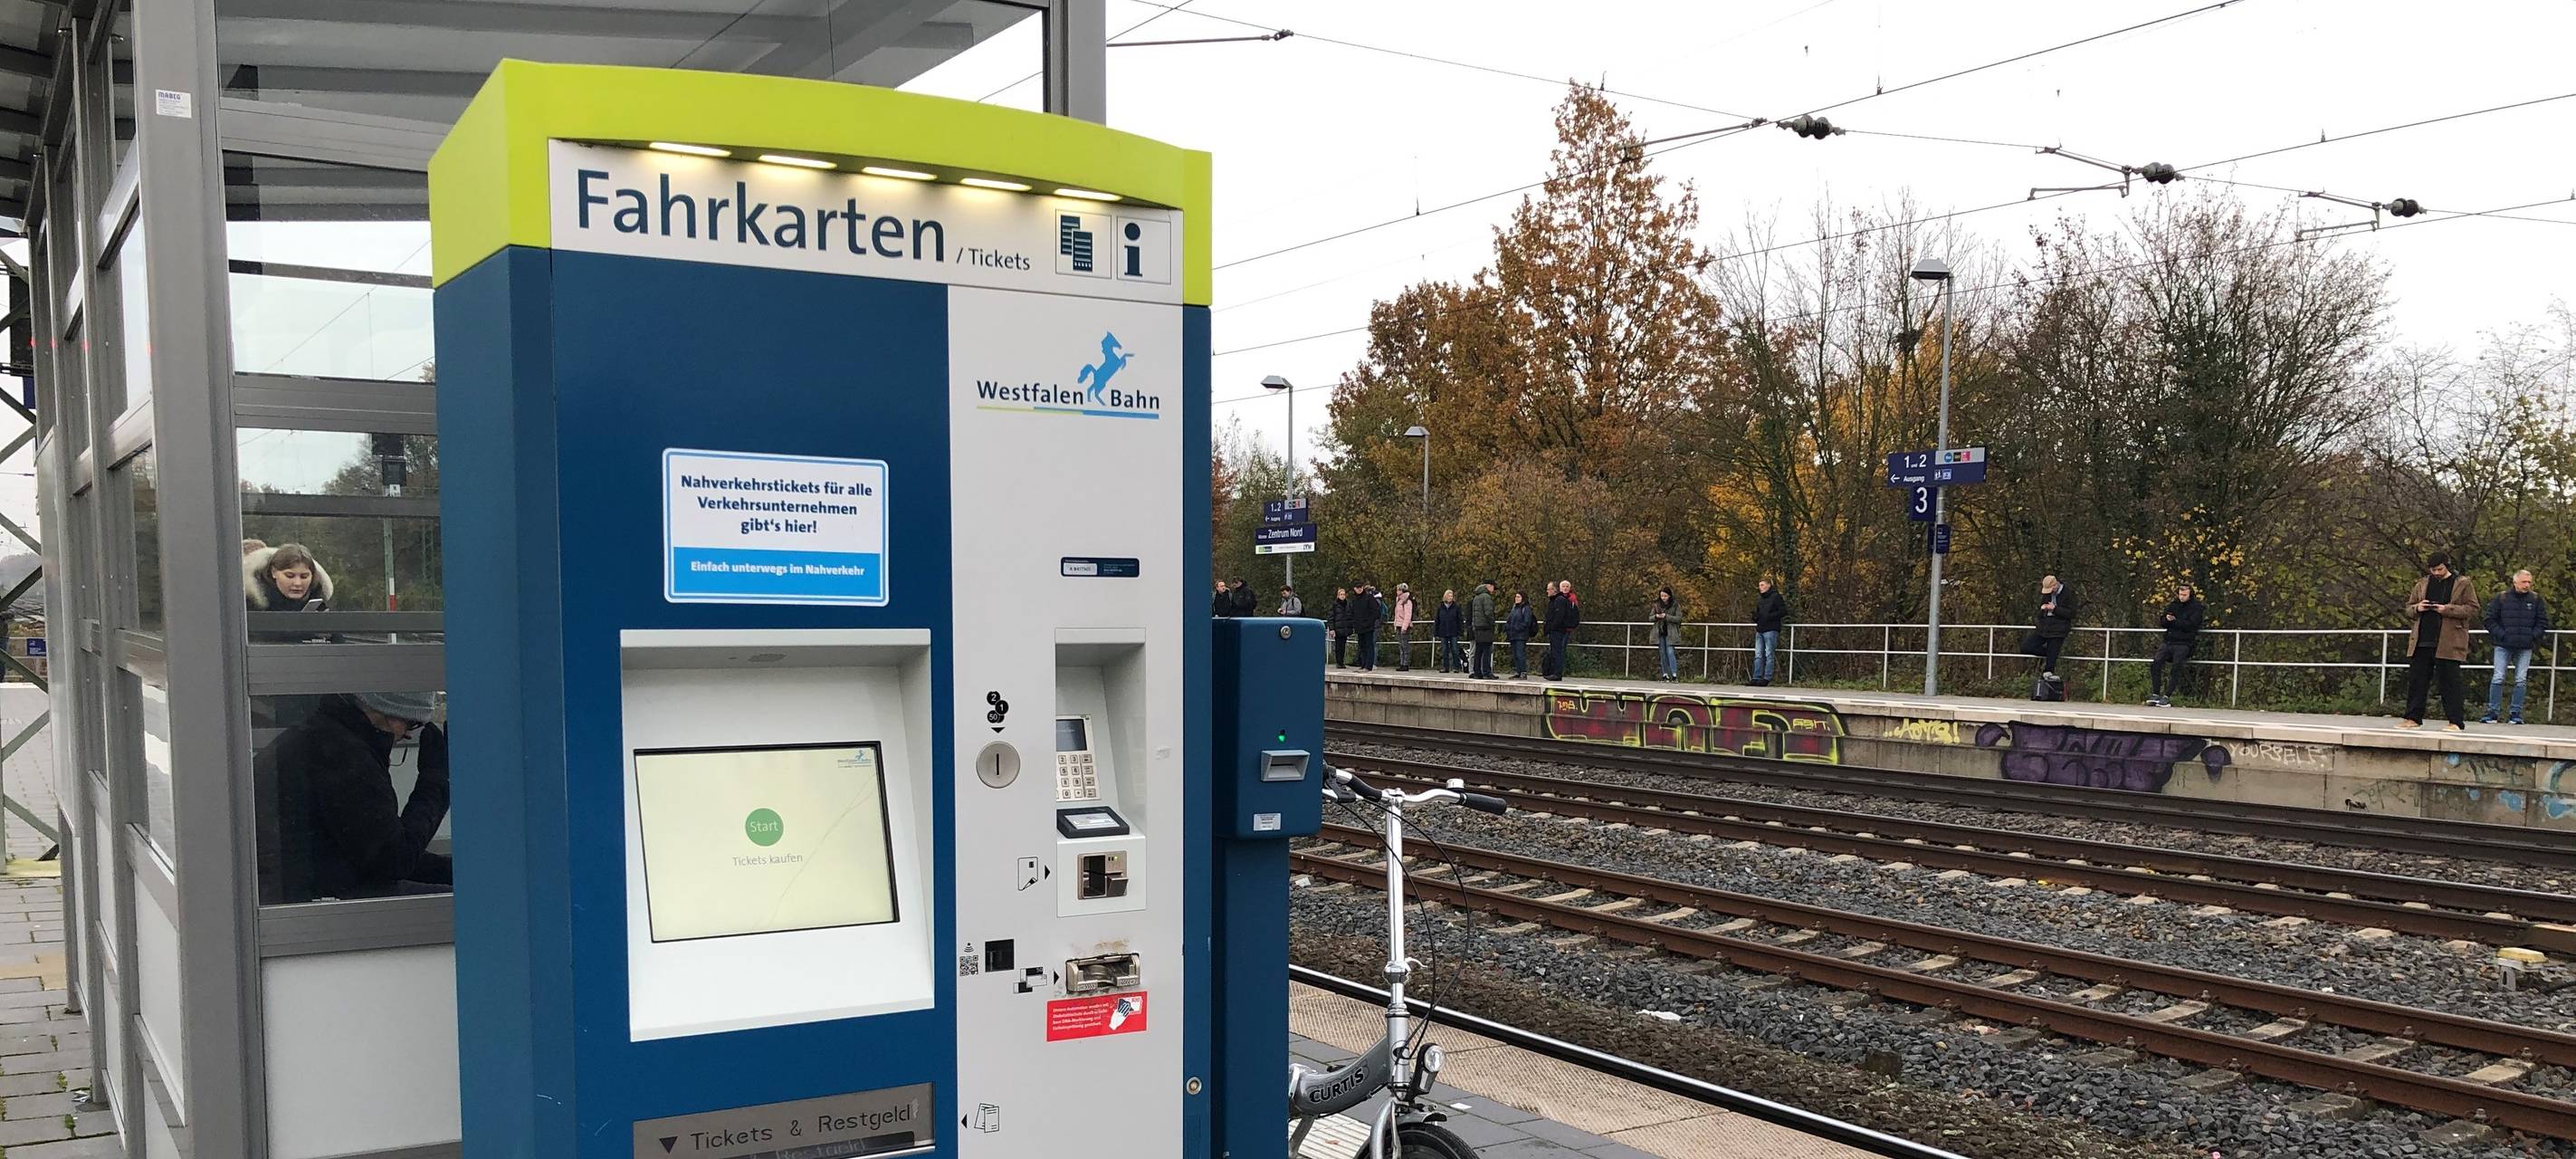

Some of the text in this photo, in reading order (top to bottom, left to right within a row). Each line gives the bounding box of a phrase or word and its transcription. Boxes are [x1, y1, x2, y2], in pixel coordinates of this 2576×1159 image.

[578, 169, 944, 263] Fahrkarten
[968, 247, 1030, 271] Tickets
[976, 379, 1160, 409] Westfalen Bahn
[1904, 455, 1910, 468] 1
[1919, 454, 1927, 467] 2
[681, 474, 873, 496] Nahverkehrstickets für alle
[697, 496, 857, 515] Verkehrsunternehmen
[1915, 487, 1928, 513] 3
[785, 519, 817, 533] hier!
[1268, 529, 1289, 539] Zentrum
[1290, 527, 1303, 537] Nord
[691, 560, 864, 576] Einfach unterwegs im Nahverkehr
[991, 694, 997, 702] 2
[989, 713, 997, 721] 50
[749, 820, 778, 832] Start
[731, 853, 803, 867] Tickets kaufen
[1309, 1067, 1366, 1103] CURTIS
[691, 1104, 911, 1151] Tickets & Restgeld
